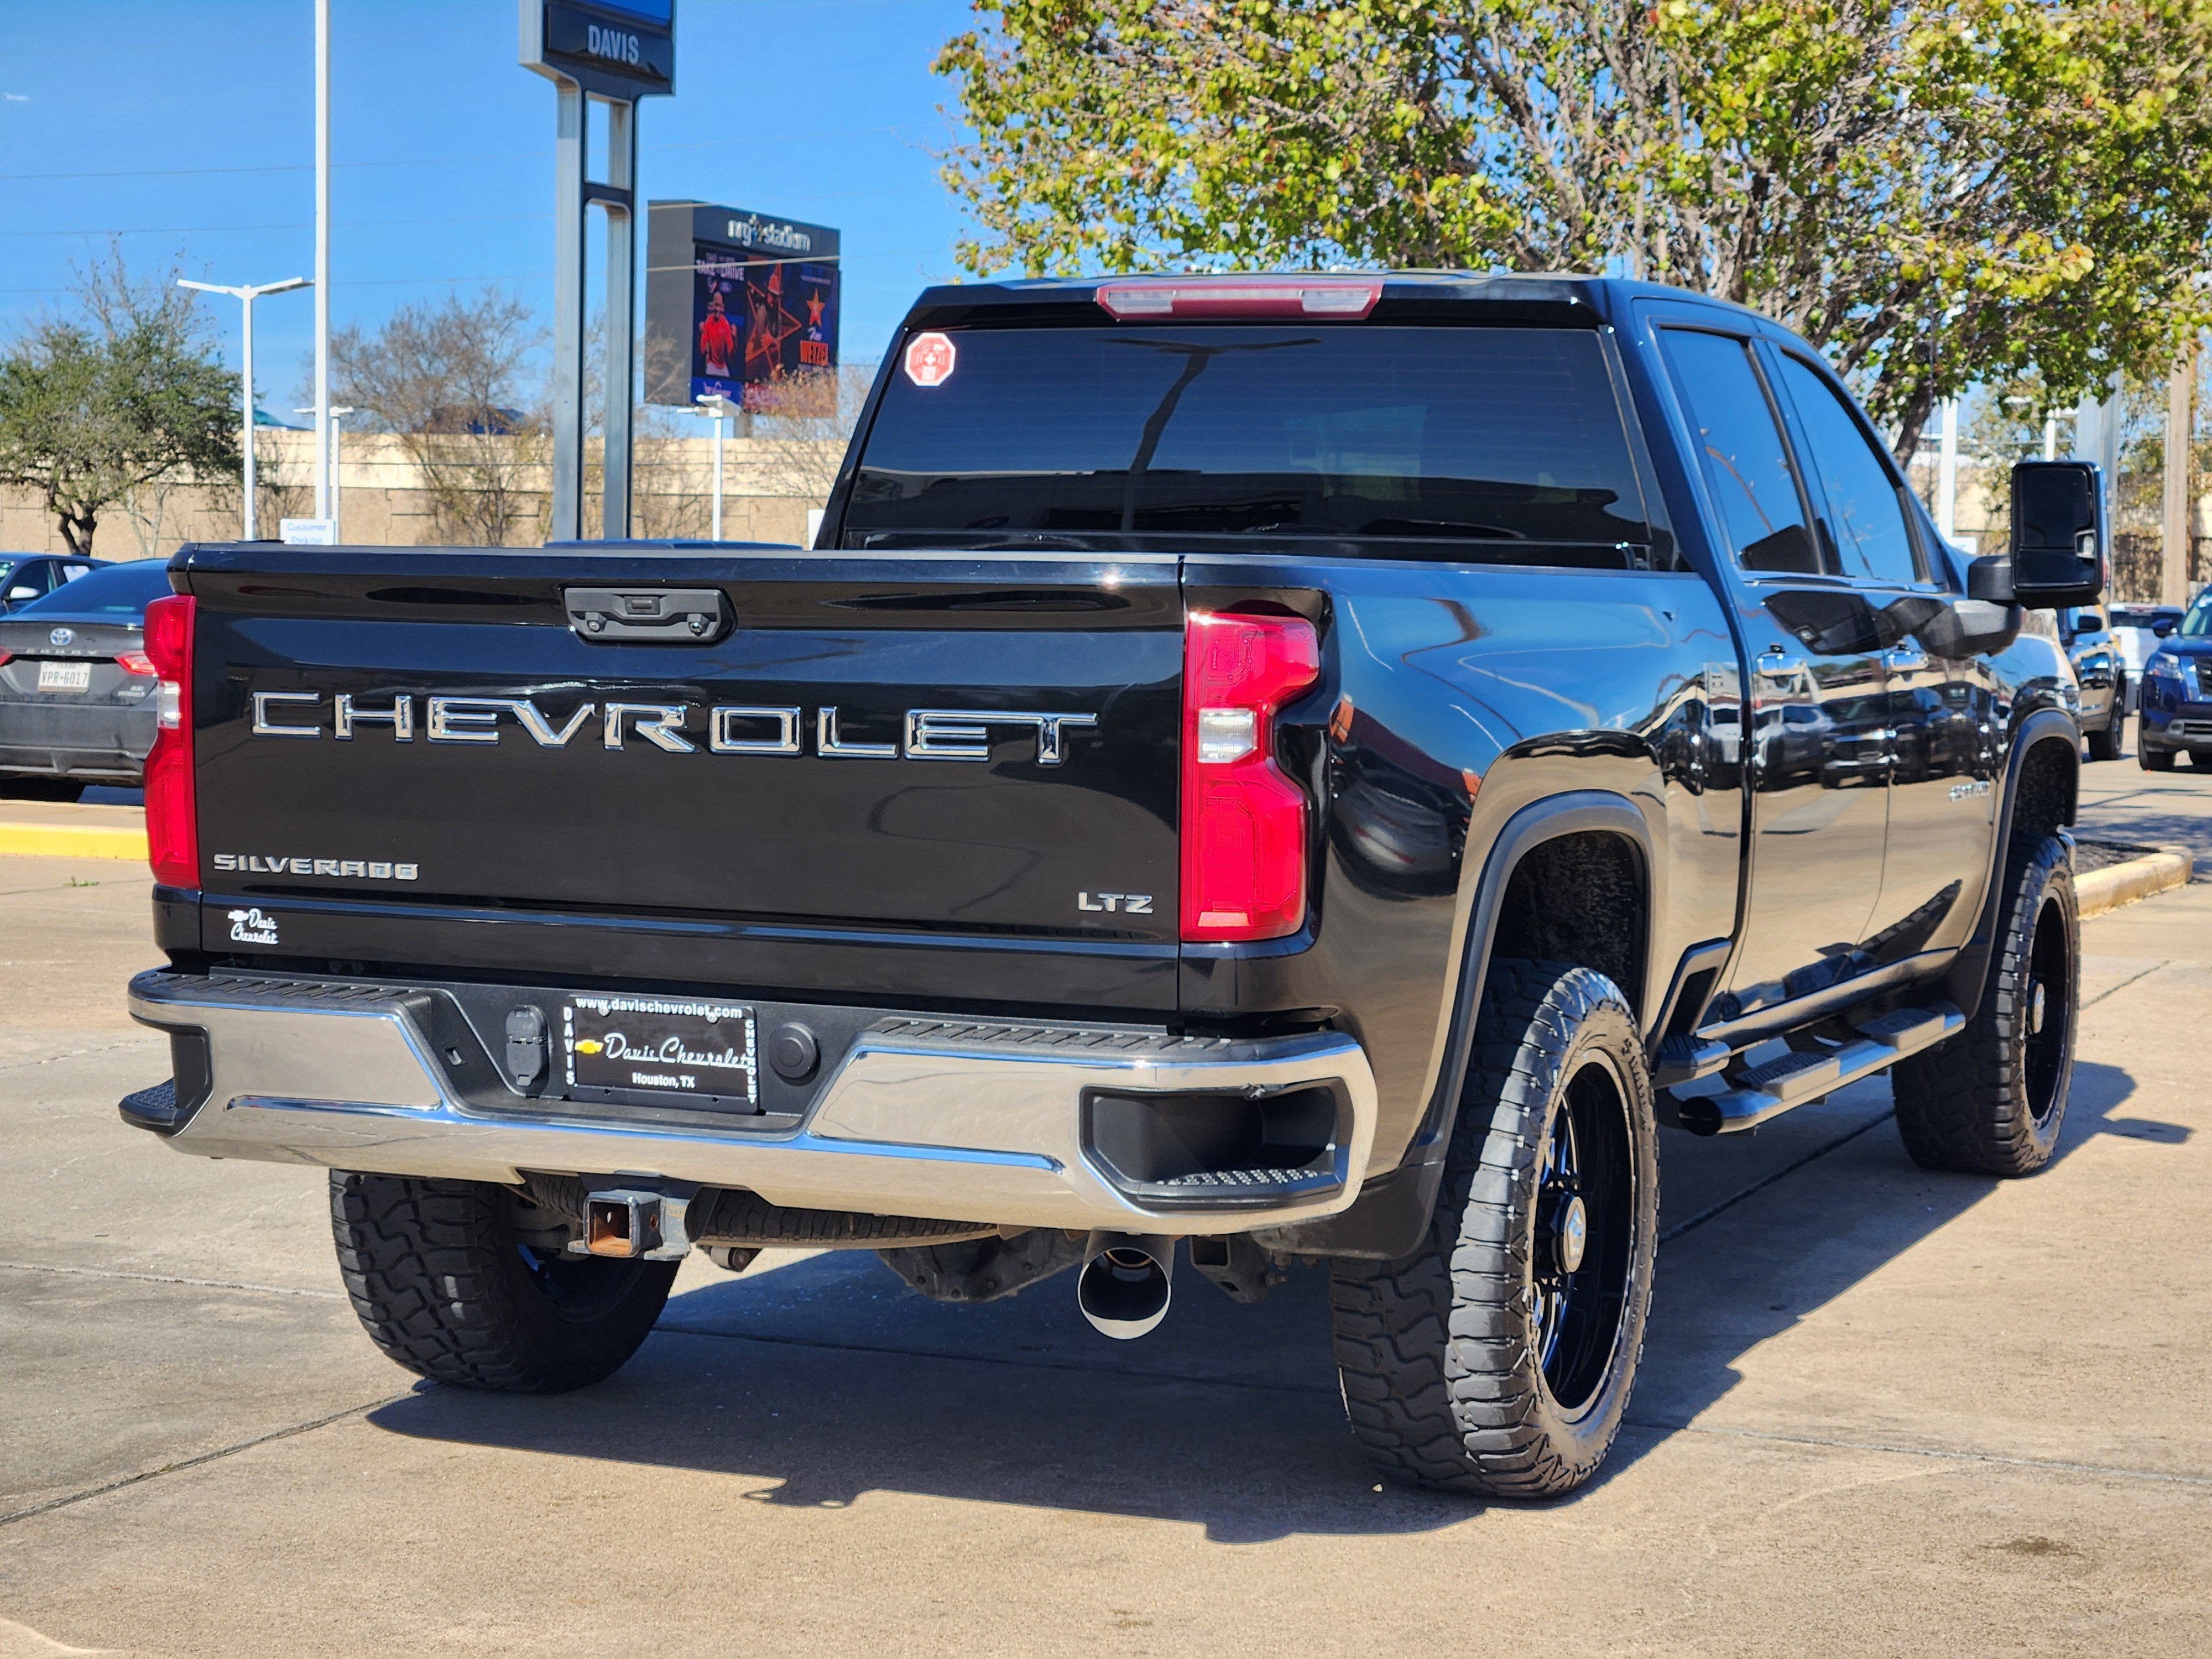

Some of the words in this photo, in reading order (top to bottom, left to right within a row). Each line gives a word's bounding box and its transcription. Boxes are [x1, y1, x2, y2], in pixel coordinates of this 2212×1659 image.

[587, 24, 639, 64] DAVIS
[763, 223, 811, 252] stadium
[252, 691, 1098, 764] CHEVROLET
[213, 853, 419, 880] SILVERADO
[1078, 891, 1154, 914] LTZ
[248, 907, 278, 930] Davis
[229, 922, 279, 945] Chevrolet
[575, 997, 743, 1019] www.davischevrolet.com
[563, 1006, 576, 1086] DAVIS
[603, 1031, 660, 1062] Davis
[659, 1036, 750, 1070] Chevrolet
[744, 1018, 758, 1104] CHEVROLET
[632, 1071, 679, 1088] Houston,
[680, 1075, 696, 1088] TX
